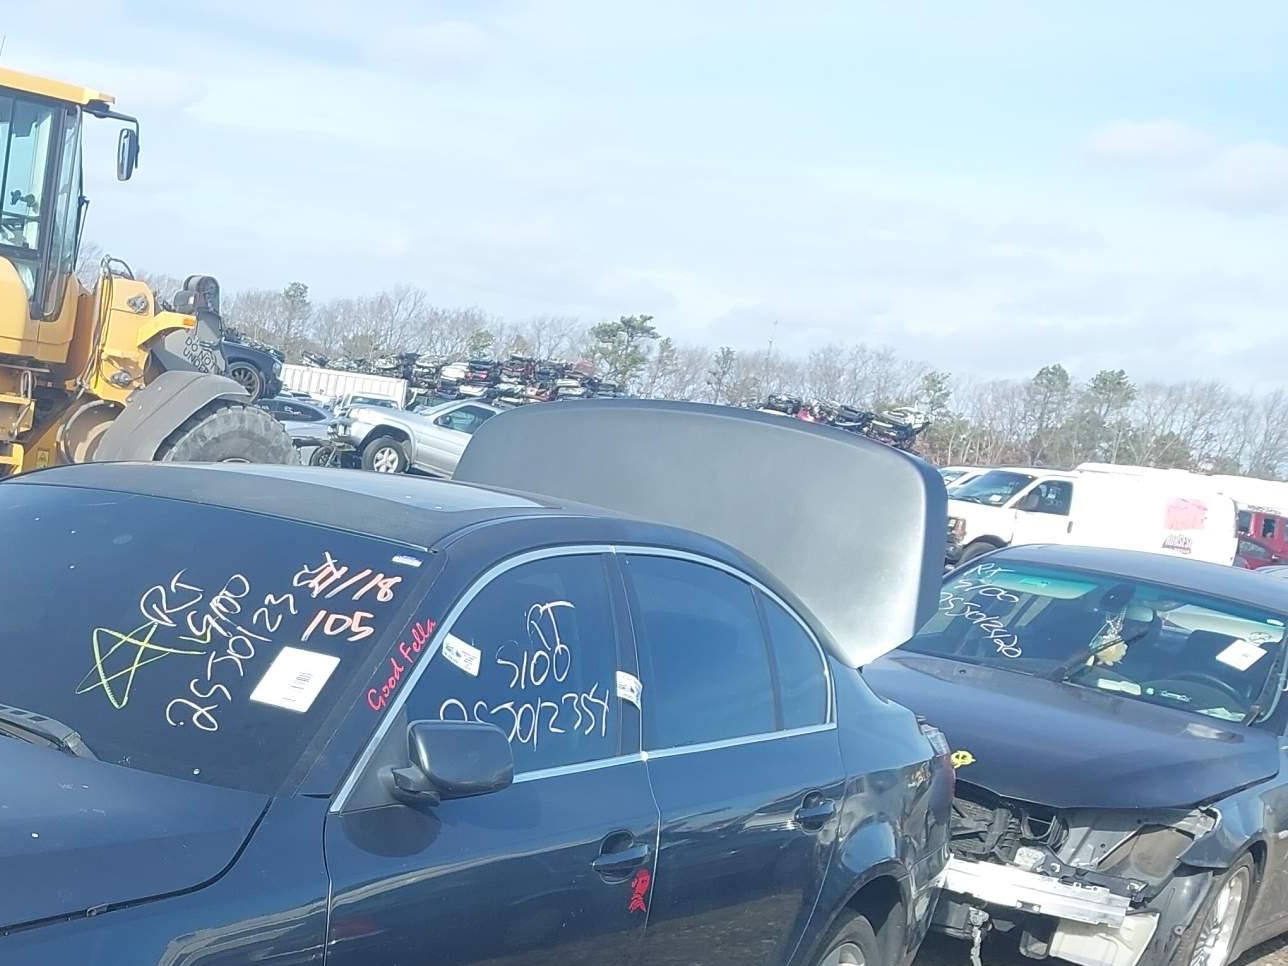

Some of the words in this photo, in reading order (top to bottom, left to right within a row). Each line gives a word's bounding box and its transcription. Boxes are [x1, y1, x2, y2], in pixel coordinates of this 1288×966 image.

[185, 336, 199, 352] DO
[197, 350, 217, 371] NOT
[300, 609, 375, 642] 105
[367, 656, 405, 711] Good
